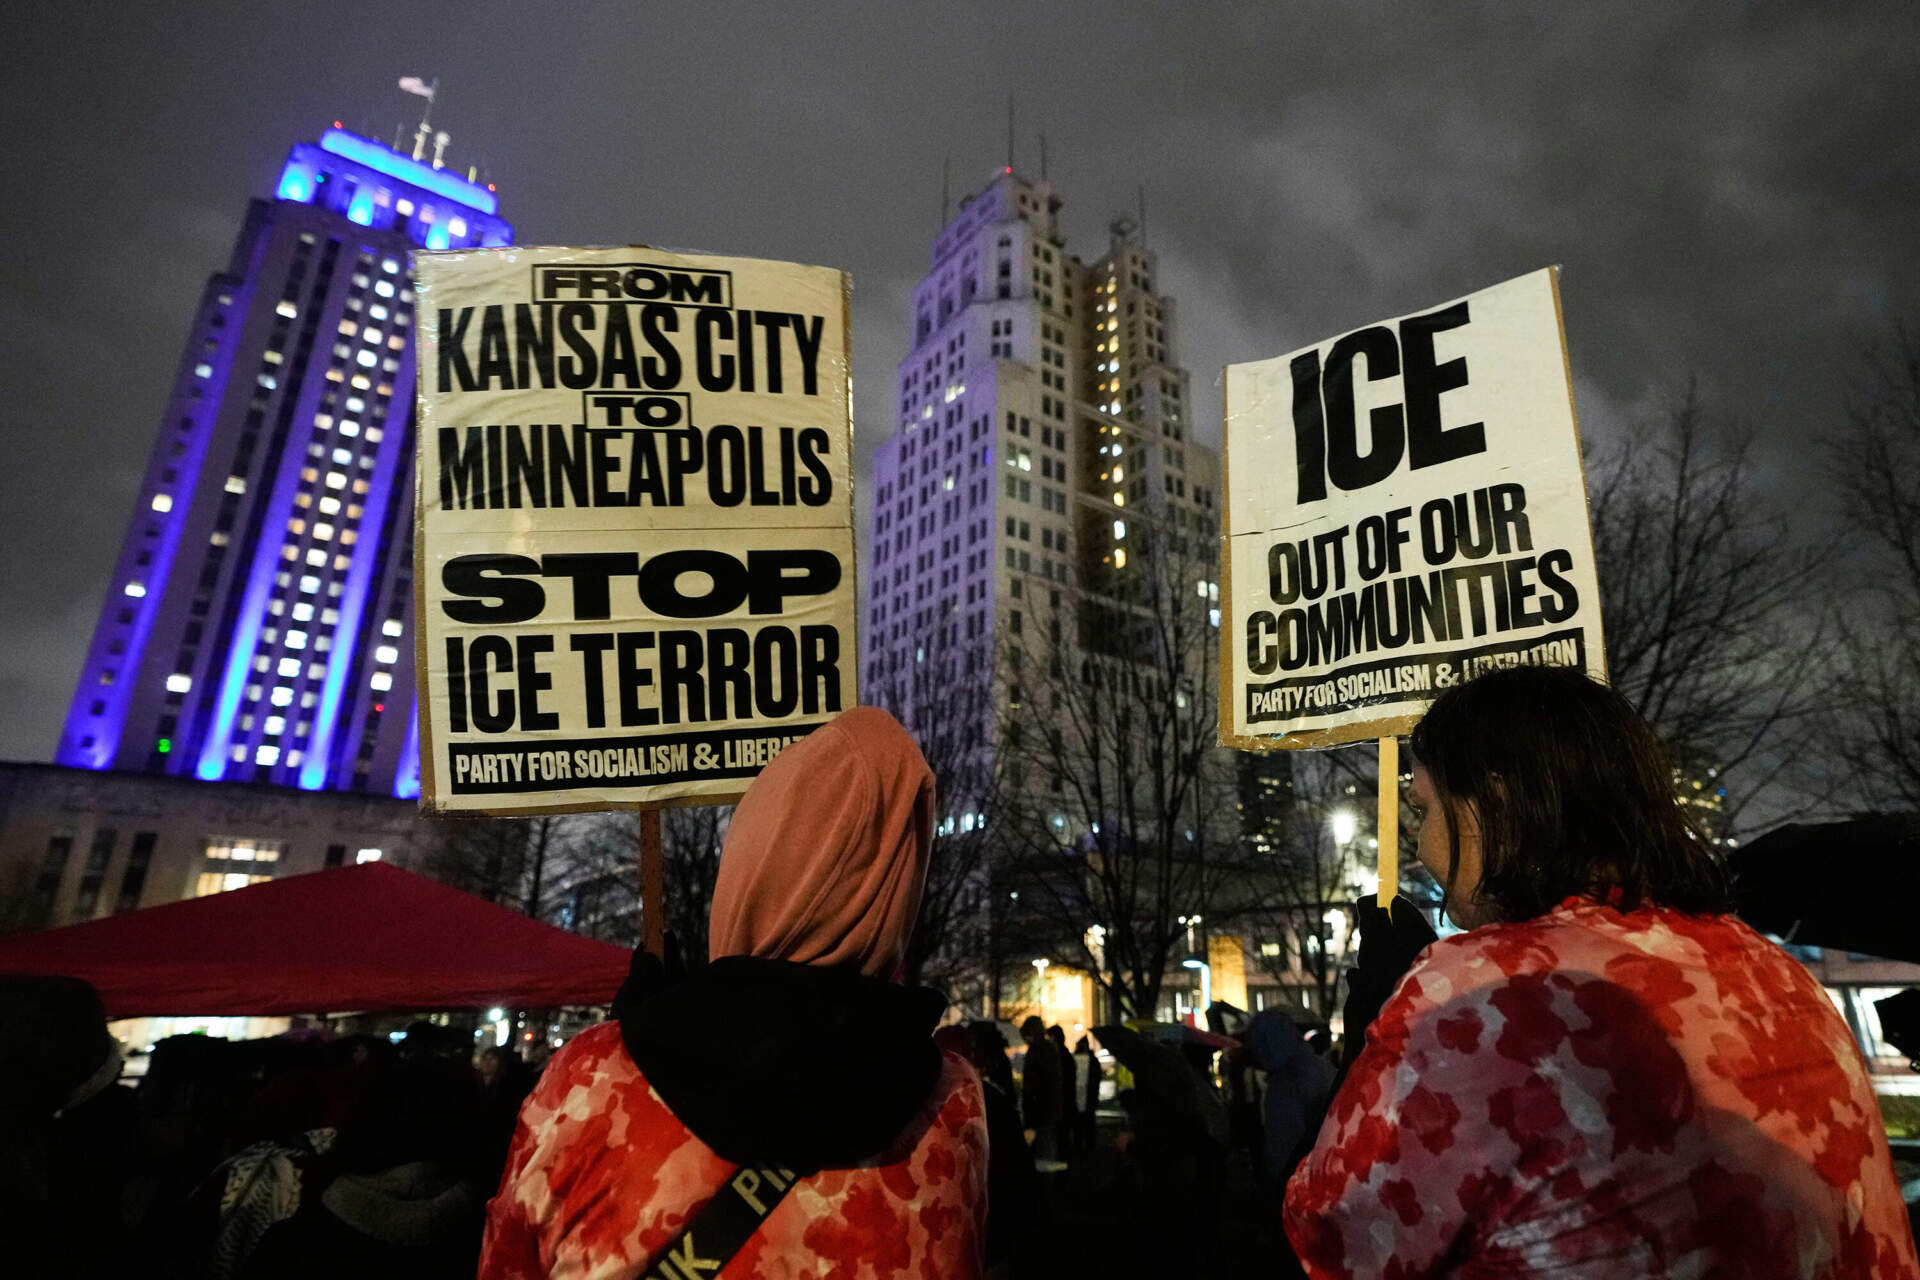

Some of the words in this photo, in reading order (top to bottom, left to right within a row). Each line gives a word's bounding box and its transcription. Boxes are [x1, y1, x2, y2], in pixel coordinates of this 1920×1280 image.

[542, 268, 722, 305] FROM
[438, 302, 681, 392] KANSAS
[695, 307, 824, 395] CITY
[594, 397, 681, 427] TO
[1290, 300, 1487, 505] ICE
[438, 424, 833, 510] MINNEAPOLIS
[441, 549, 841, 624] STOP
[1268, 525, 1350, 605] OUT
[1356, 506, 1412, 581] OF
[1420, 483, 1533, 566] OUR
[1247, 549, 1579, 675] COMMUNITIES
[445, 634, 560, 733] ICE
[570, 624, 842, 728] TERROR
[1252, 686, 1304, 716] PARTY
[1304, 681, 1338, 709] FOR
[1337, 664, 1431, 703] SOCIALISM
[1435, 663, 1459, 688] &
[456, 752, 524, 784] PARTY
[527, 751, 572, 781] FOR
[574, 744, 688, 779] SOCIALISM
[693, 743, 720, 770] &
